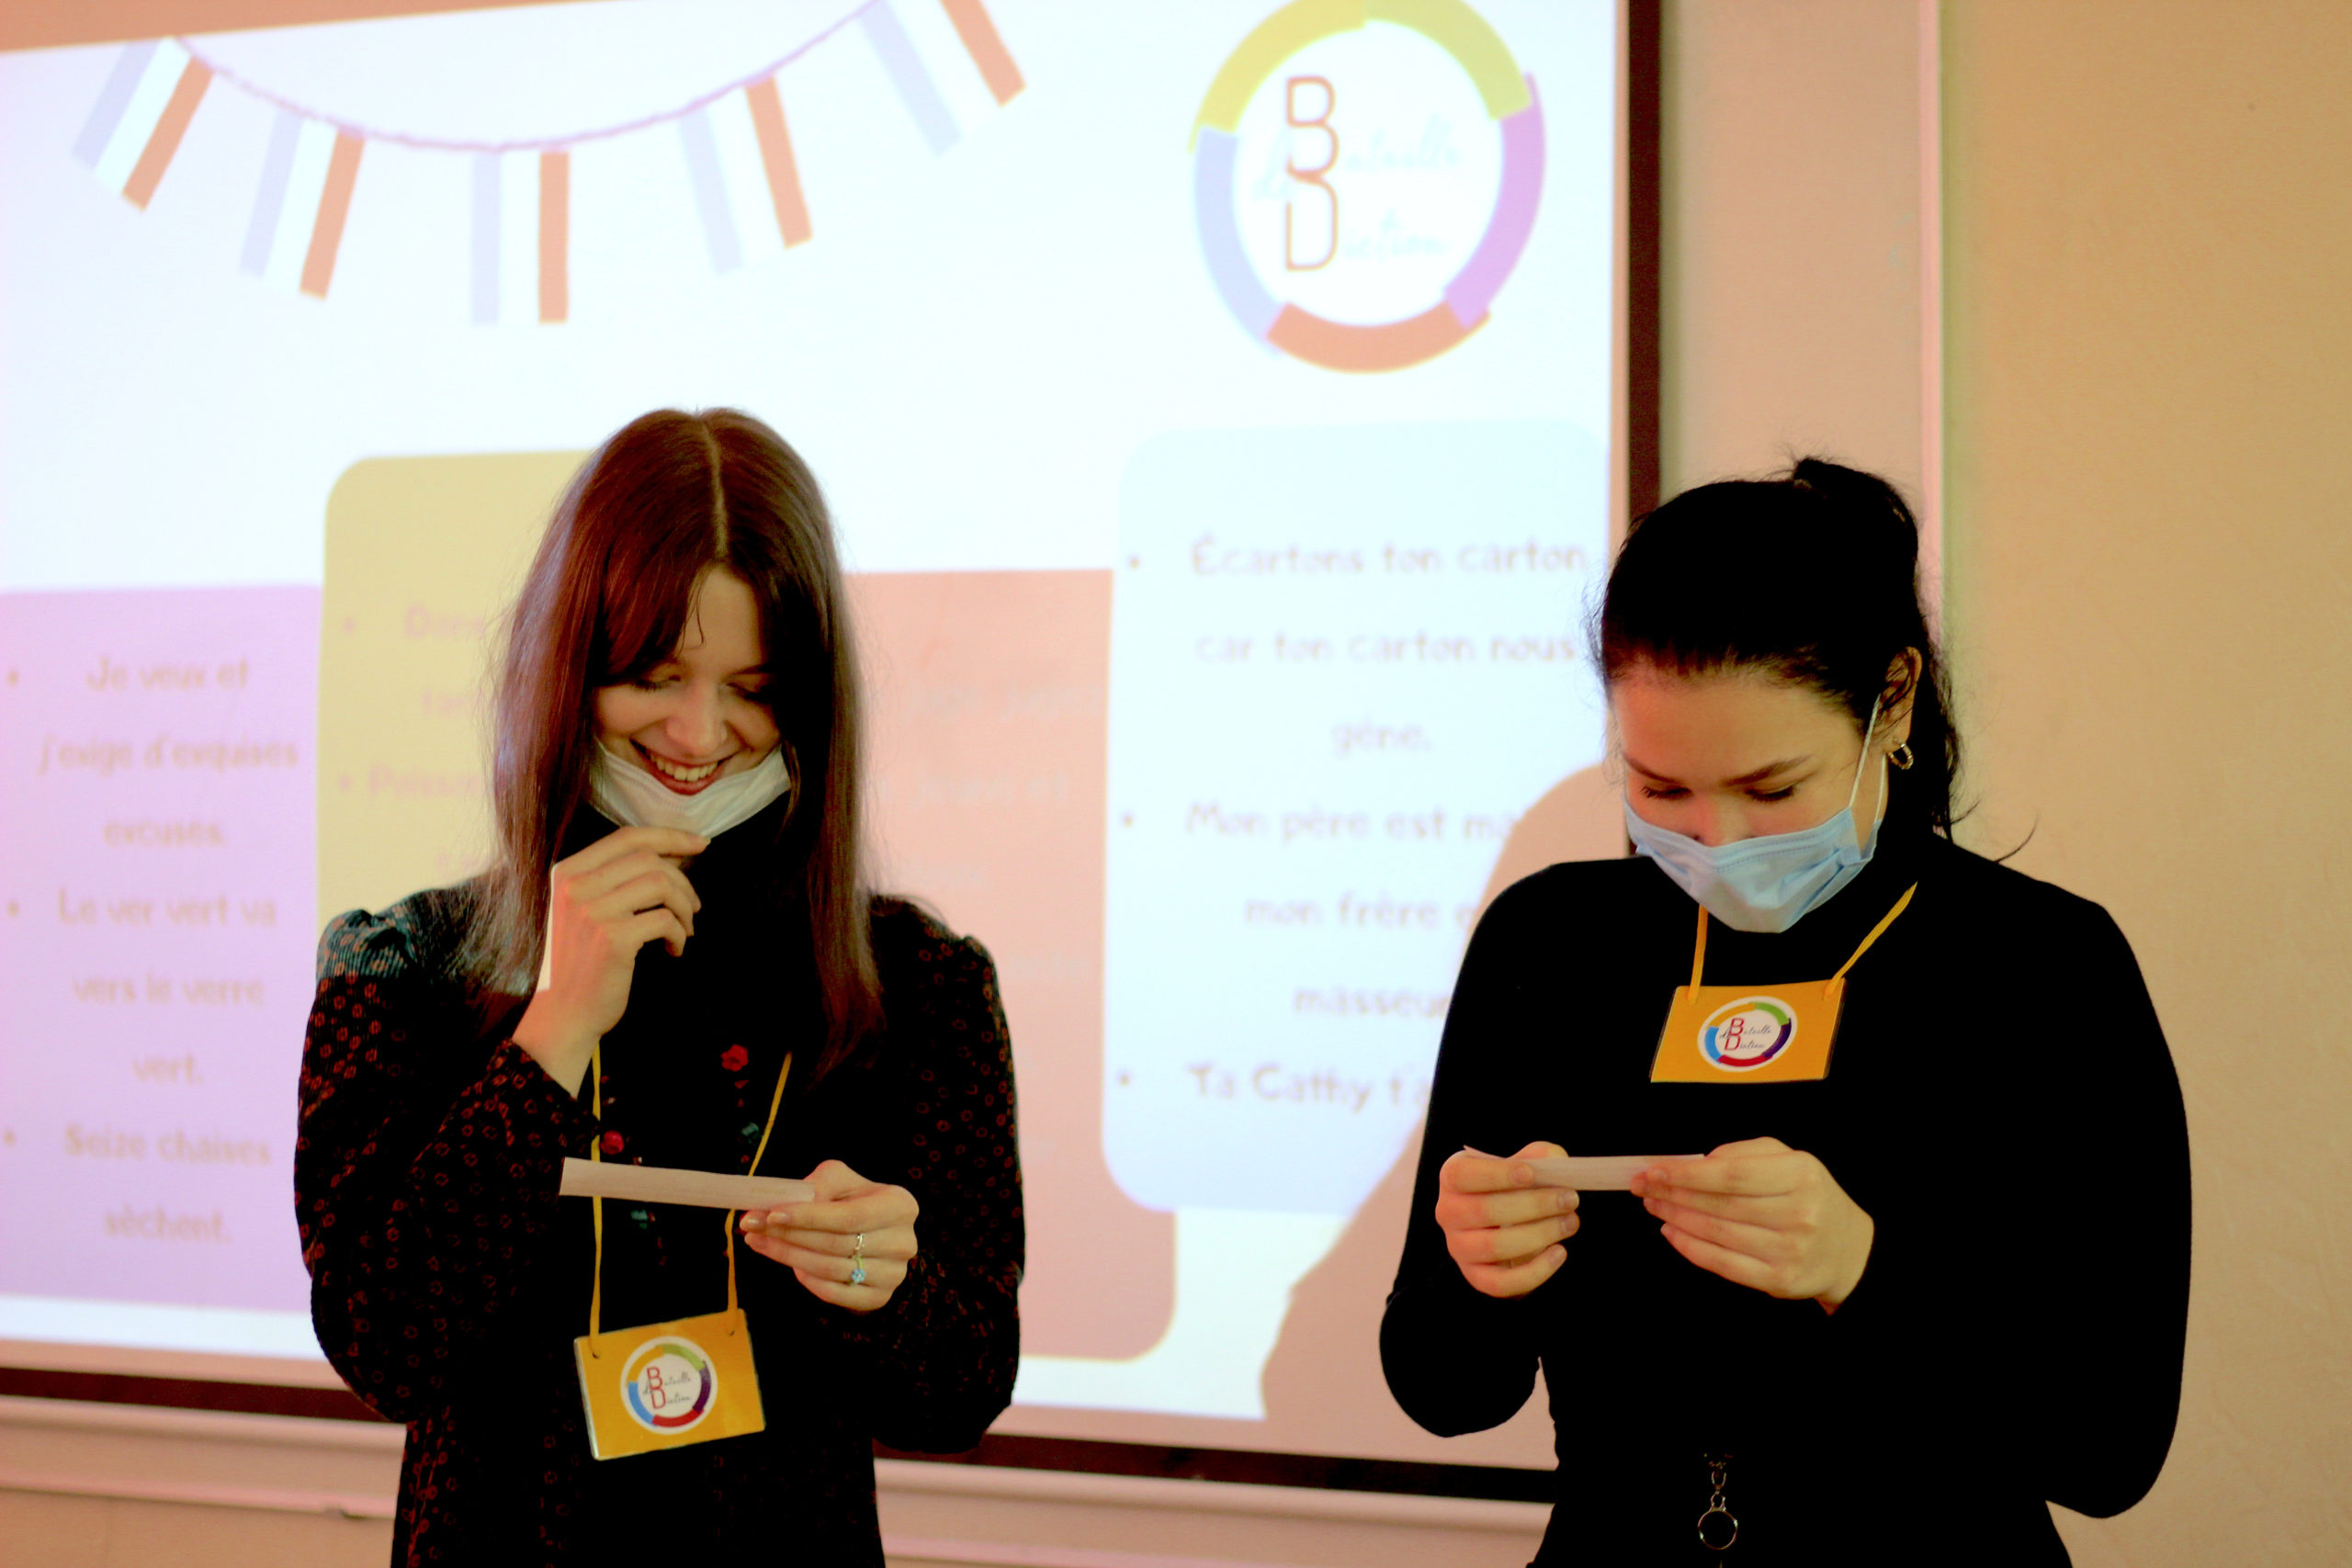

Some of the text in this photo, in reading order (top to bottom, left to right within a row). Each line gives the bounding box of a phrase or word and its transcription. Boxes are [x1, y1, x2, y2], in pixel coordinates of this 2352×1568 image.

[1191, 532, 1588, 577] Écartons ton carton
[1195, 628, 1577, 663] car ton carton nous
[85, 654, 250, 692] Je veux et
[36, 732, 299, 778] j'exige d'exquises
[102, 818, 228, 849] excuses.
[1186, 801, 1268, 838] Mon
[1281, 805, 1370, 847] père
[1385, 808, 1447, 840] est
[57, 886, 277, 928] Le ver vert va
[1243, 898, 1323, 928] mon
[1338, 890, 1440, 931] frère
[72, 970, 265, 1007] vers le verre
[132, 1051, 205, 1086] vert.
[1185, 1062, 1237, 1100] Ta
[1250, 1062, 1373, 1115] Cathy
[63, 1122, 272, 1168] Seize chaises
